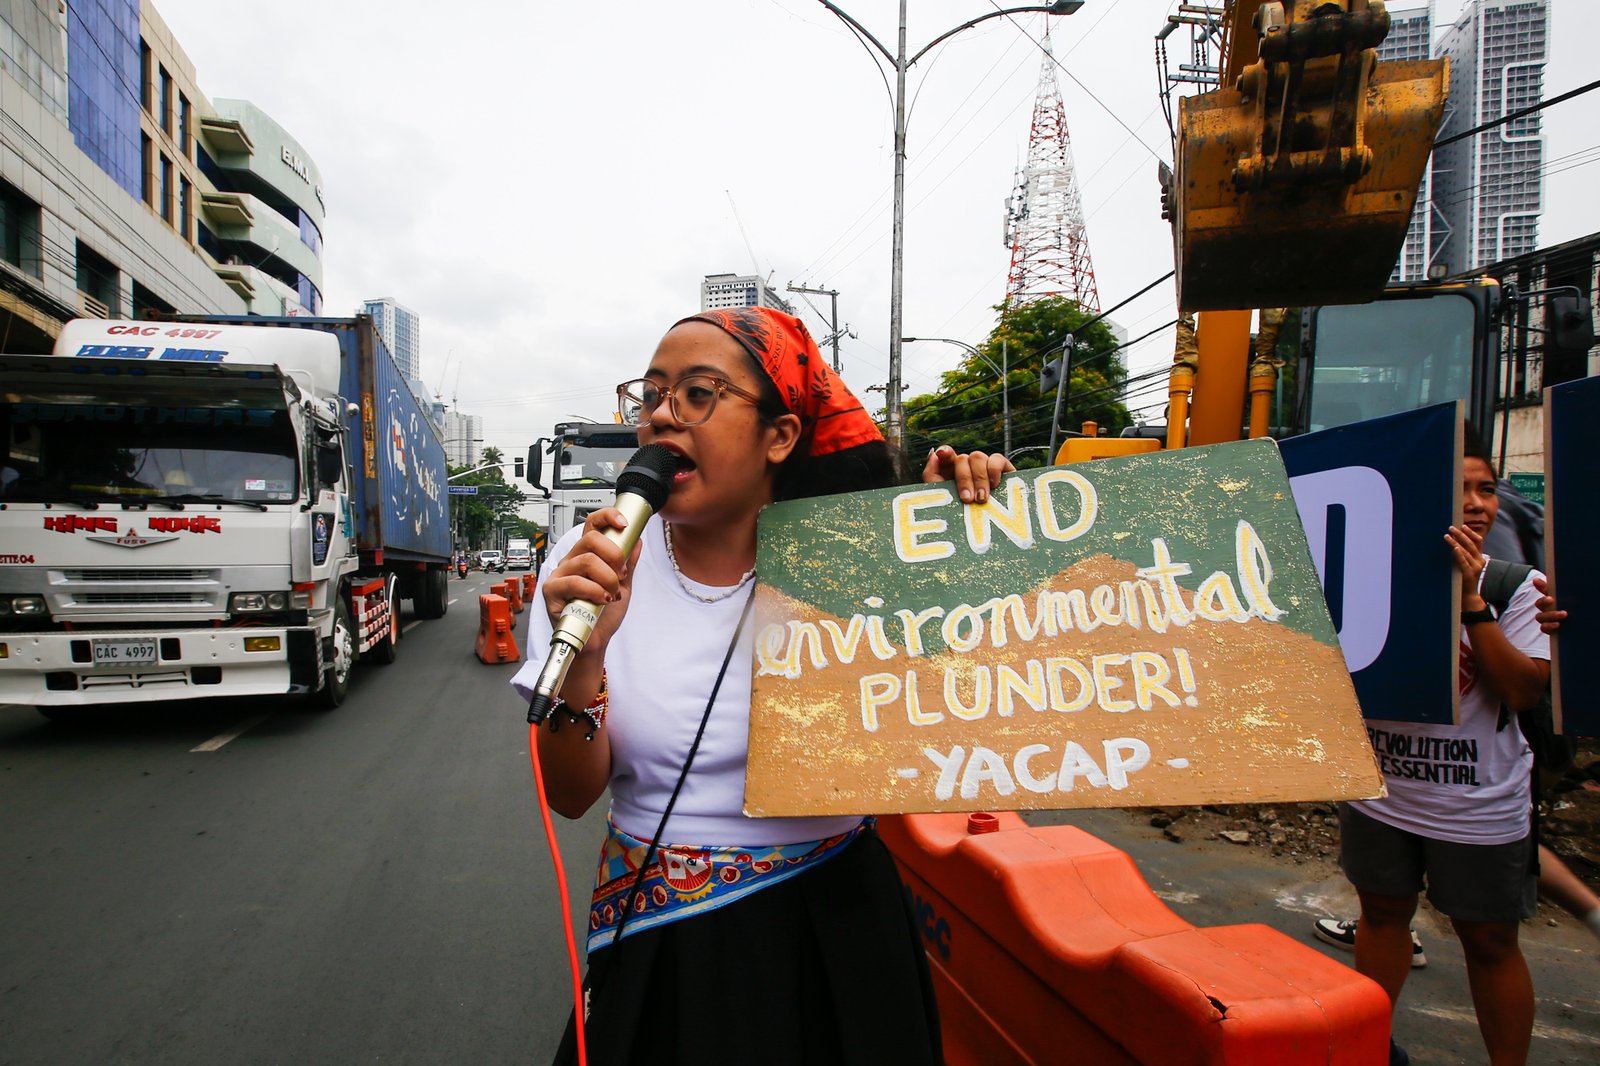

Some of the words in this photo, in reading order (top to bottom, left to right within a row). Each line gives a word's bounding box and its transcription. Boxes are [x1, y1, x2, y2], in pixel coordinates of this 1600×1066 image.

[107, 325, 159, 336] CAC
[164, 328, 222, 339] 4997
[43, 514, 118, 534] KING
[892, 469, 1098, 563] END
[755, 520, 1289, 677] environmental
[96, 647, 118, 658] CAC
[125, 646, 154, 658] 4997
[859, 647, 1199, 733] PLUNDER!
